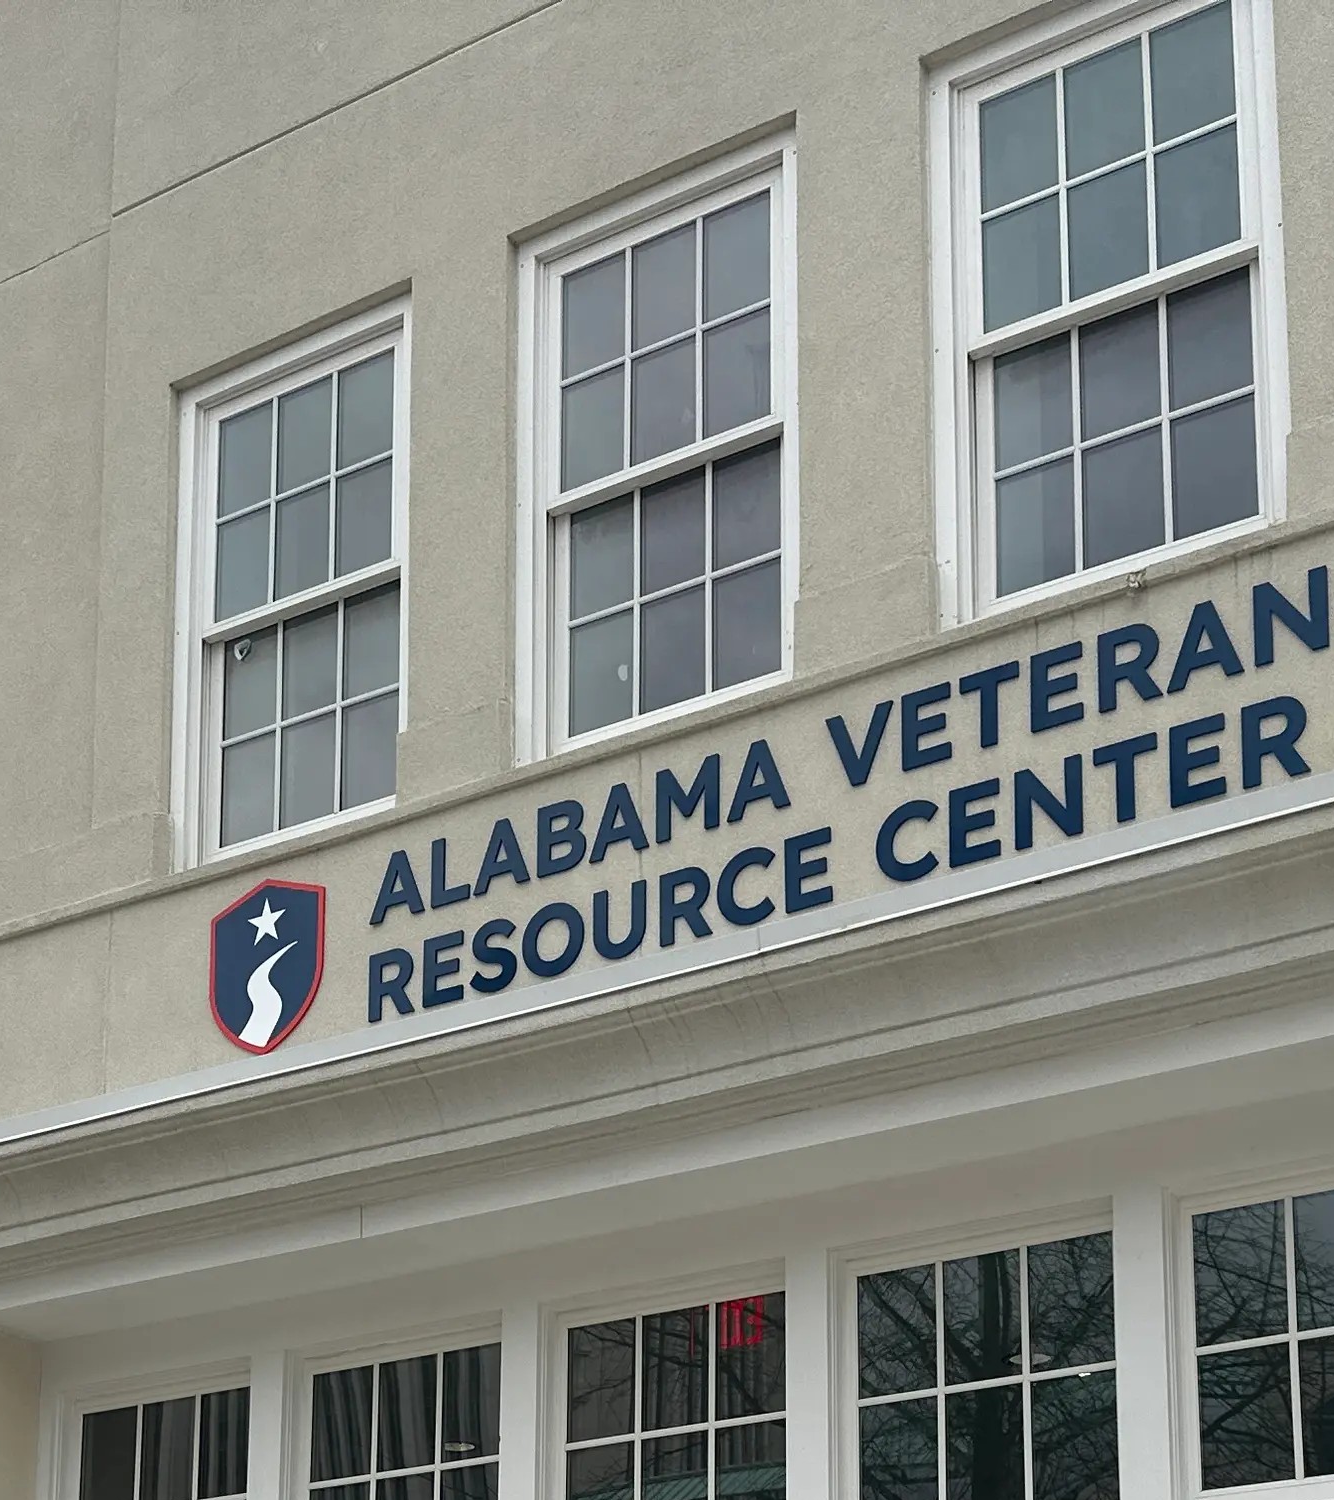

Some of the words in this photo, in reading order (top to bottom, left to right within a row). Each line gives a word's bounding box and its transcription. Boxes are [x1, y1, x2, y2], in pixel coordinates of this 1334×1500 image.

[367, 827, 833, 1021] RESOURCE
[876, 695, 1306, 882] CENTER
[373, 741, 789, 923] ALABAMA
